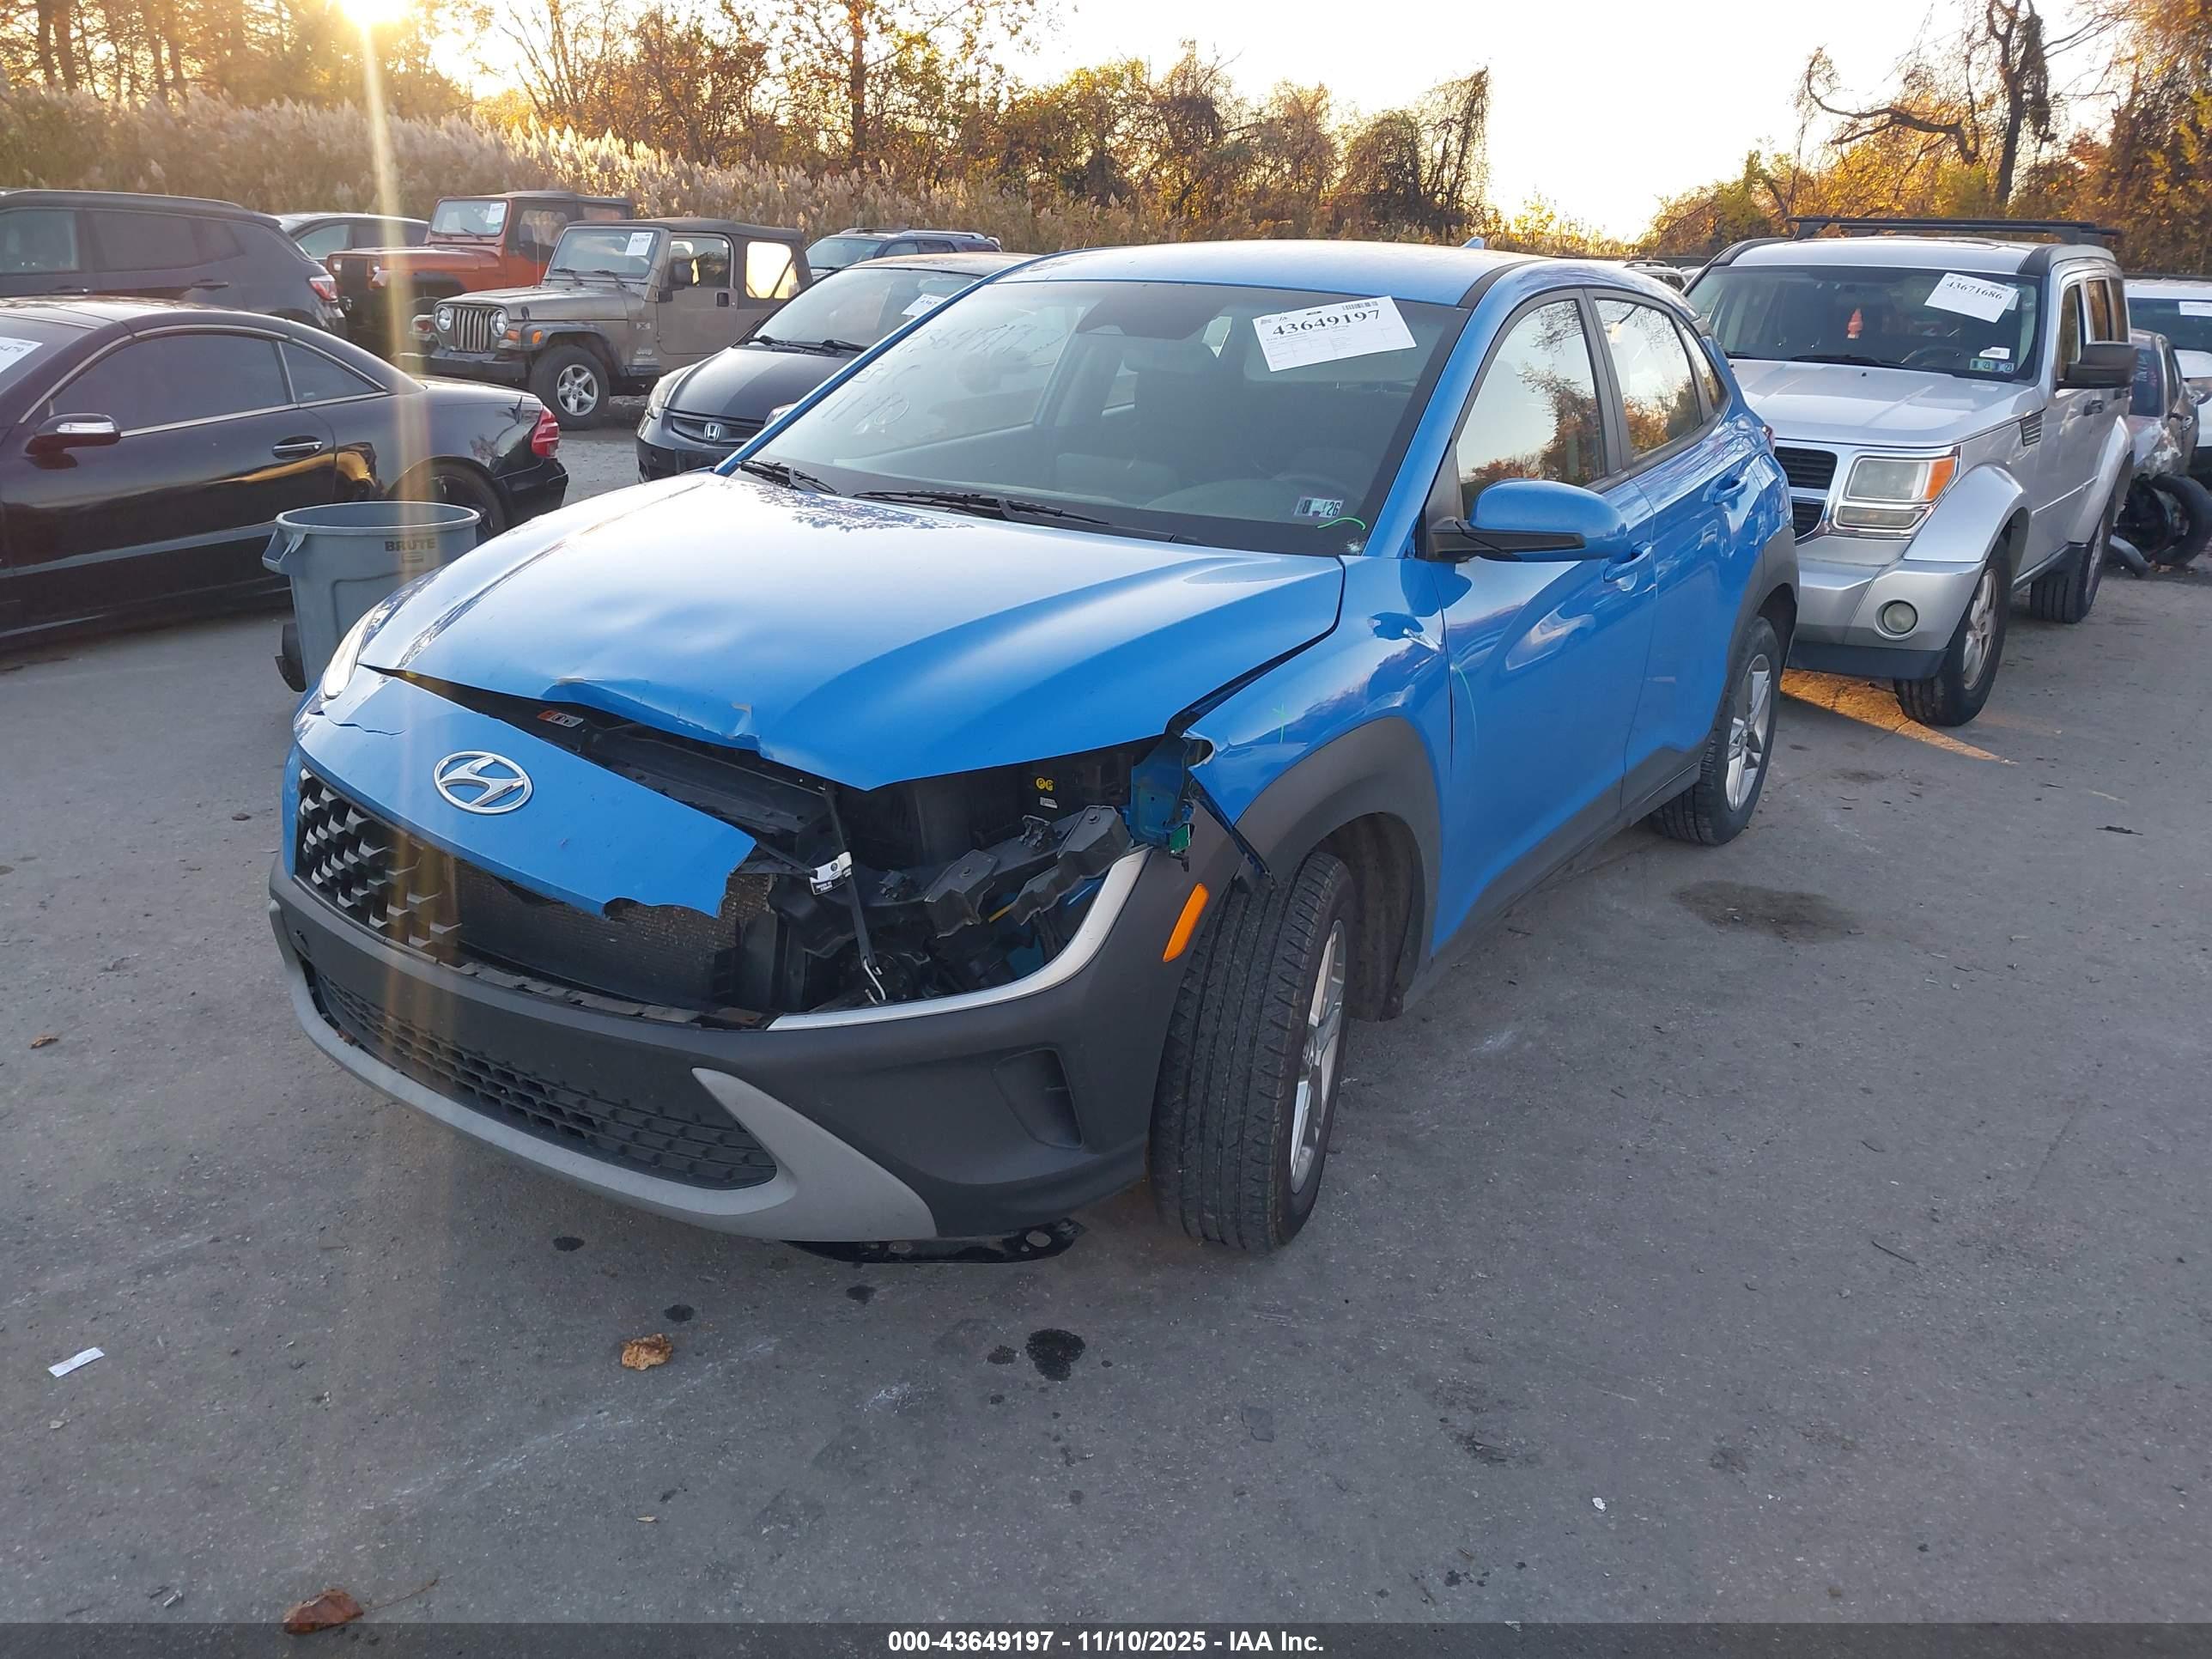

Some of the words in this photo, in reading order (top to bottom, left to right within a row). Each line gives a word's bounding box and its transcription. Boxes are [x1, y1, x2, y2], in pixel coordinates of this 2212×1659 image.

[1946, 281, 2003, 301] 43671686
[1273, 309, 1380, 336] 43649197
[1327, 501, 1340, 516] 26
[384, 538, 436, 552] BRUTE
